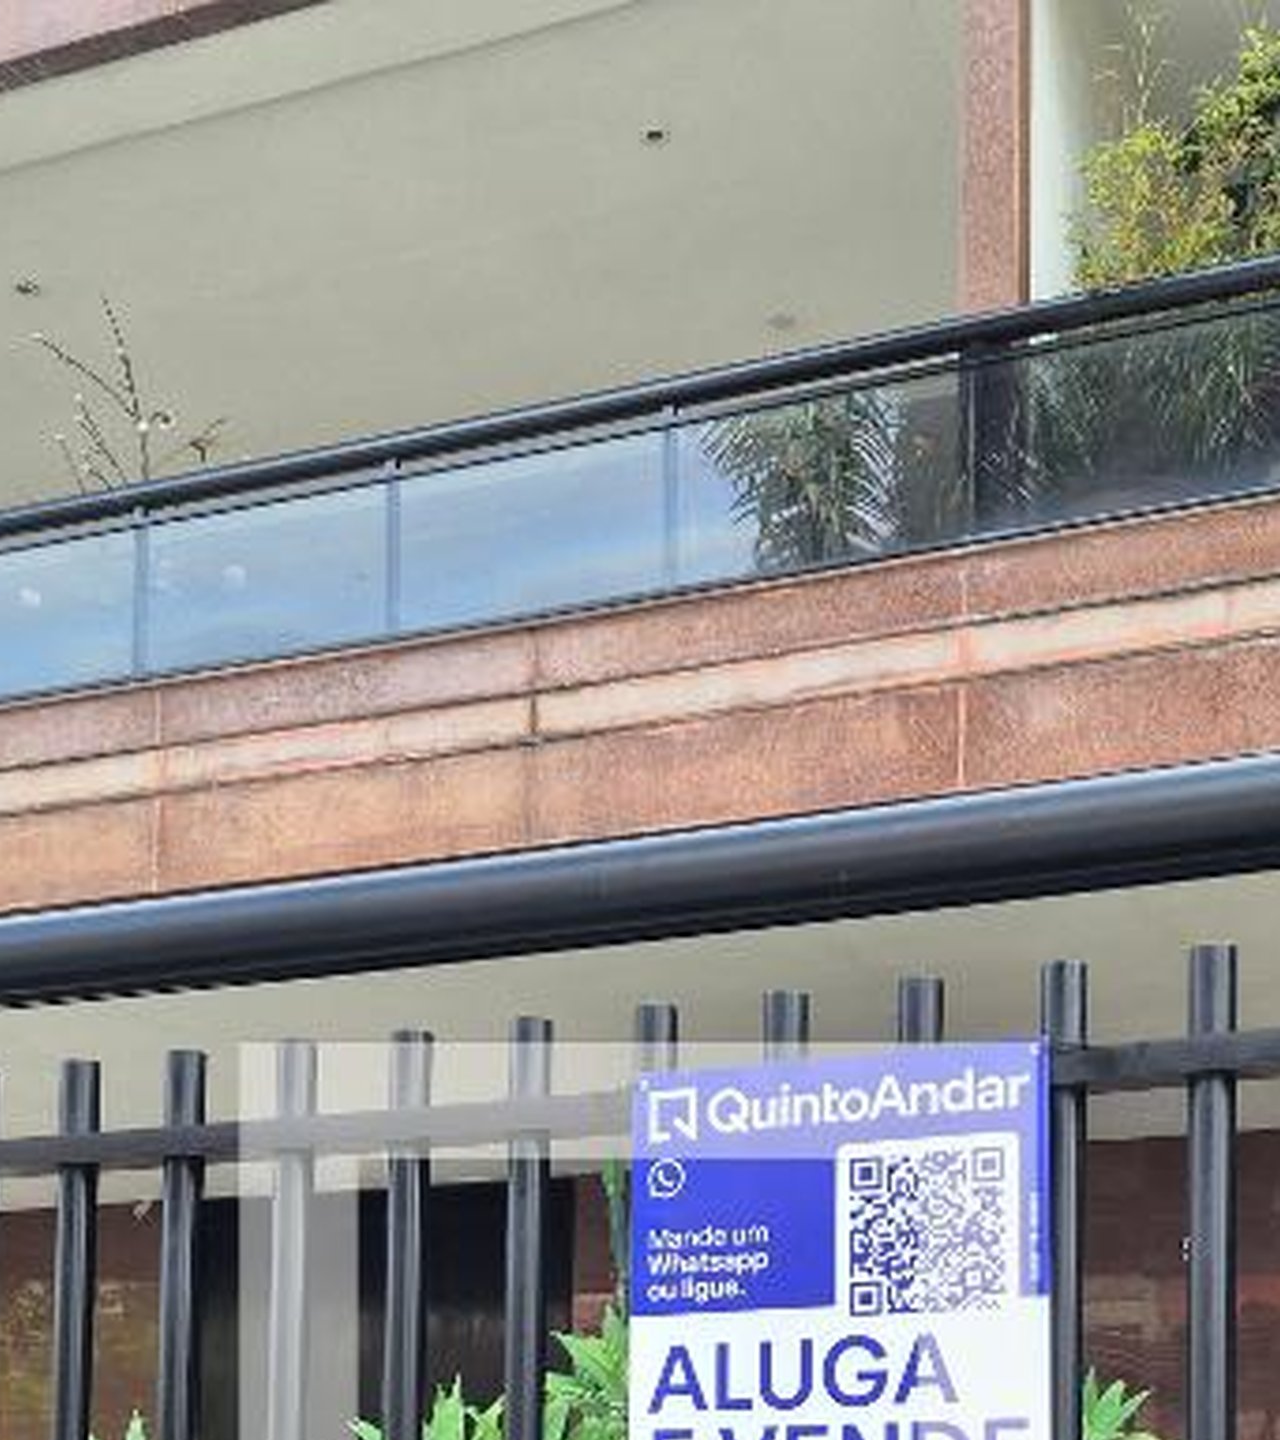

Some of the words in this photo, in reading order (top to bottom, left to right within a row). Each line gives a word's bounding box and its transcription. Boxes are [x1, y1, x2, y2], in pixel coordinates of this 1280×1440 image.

[707, 1067, 1030, 1133] QuintoAndar
[731, 1225, 769, 1247] um
[646, 1284, 677, 1303] ou
[680, 1277, 747, 1305] ligue.
[648, 1332, 960, 1413] ALUGA
